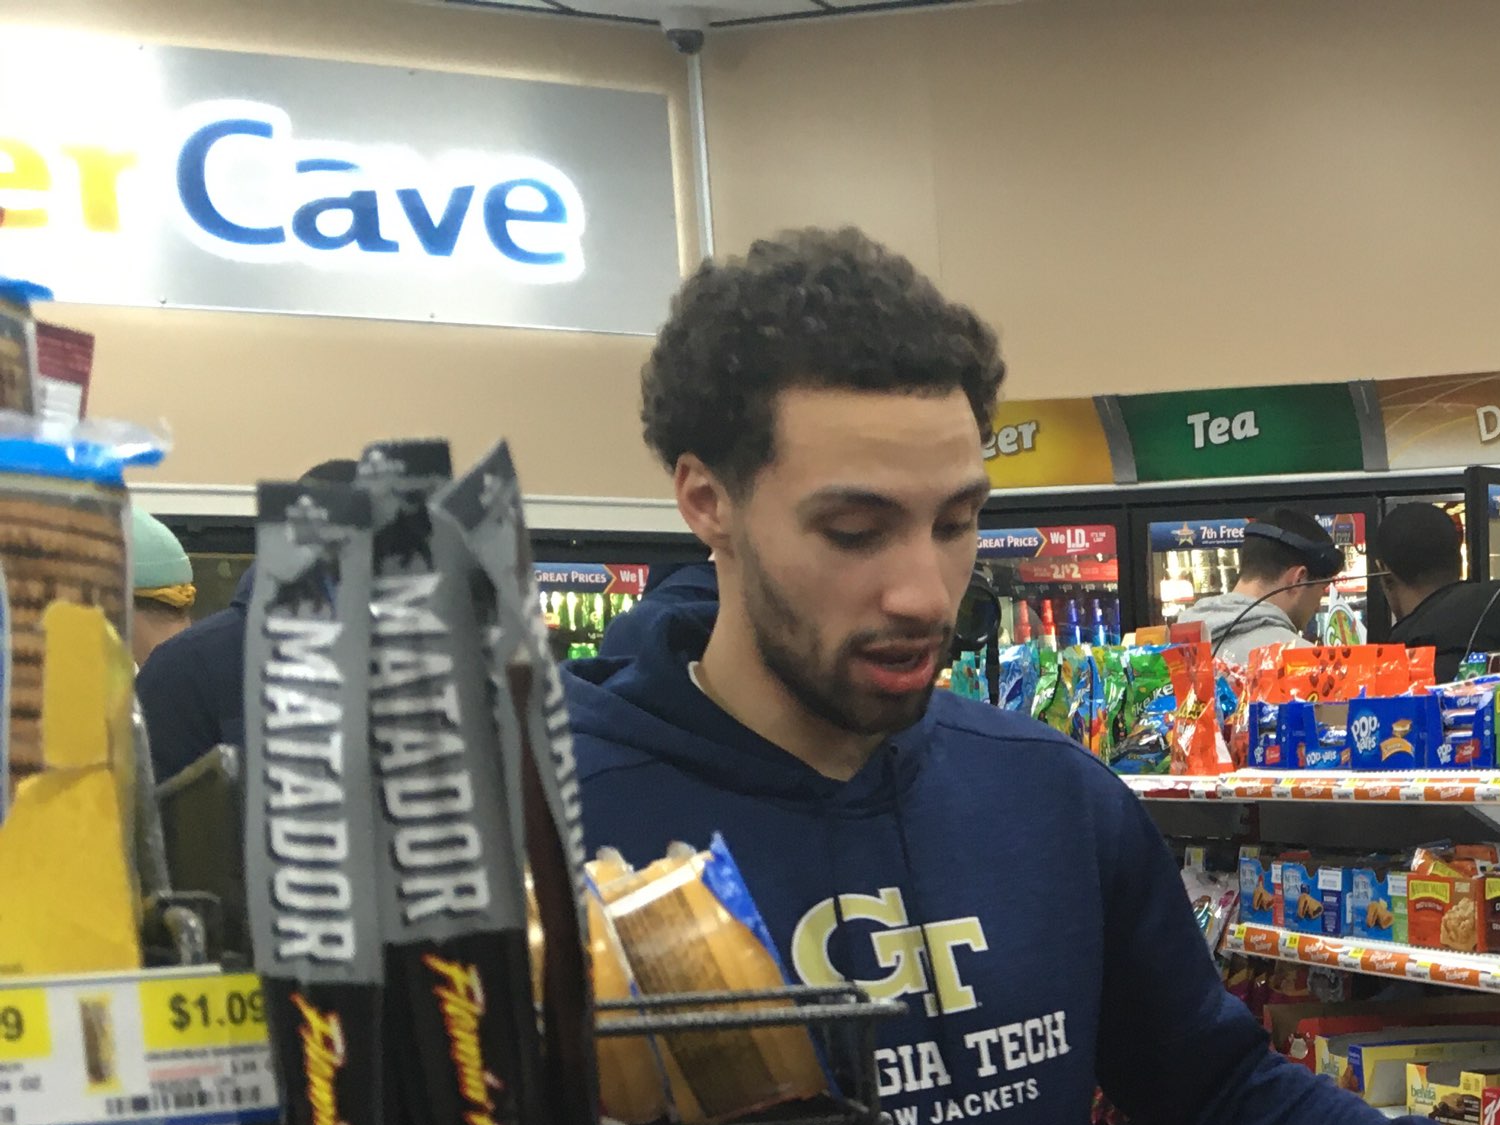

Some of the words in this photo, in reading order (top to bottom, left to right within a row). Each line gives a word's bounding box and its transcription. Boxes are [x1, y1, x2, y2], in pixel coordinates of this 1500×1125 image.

[177, 119, 568, 264] Cave
[982, 421, 1038, 459] eer
[1187, 410, 1260, 450] Tea
[977, 535, 1005, 549] GREAT
[1007, 534, 1039, 548] PRICES
[1050, 531, 1065, 545] We
[1066, 528, 1090, 549] I.D.
[1200, 526, 1218, 540] 7th
[534, 569, 568, 583] GREAT
[571, 571, 607, 584] PRICES
[619, 569, 637, 583] We
[367, 573, 491, 922] MATADOR
[264, 617, 355, 963] MATADOR
[791, 886, 989, 1017] GT
[963, 1010, 1070, 1078] TECH
[929, 1078, 1040, 1124] JACKETS
